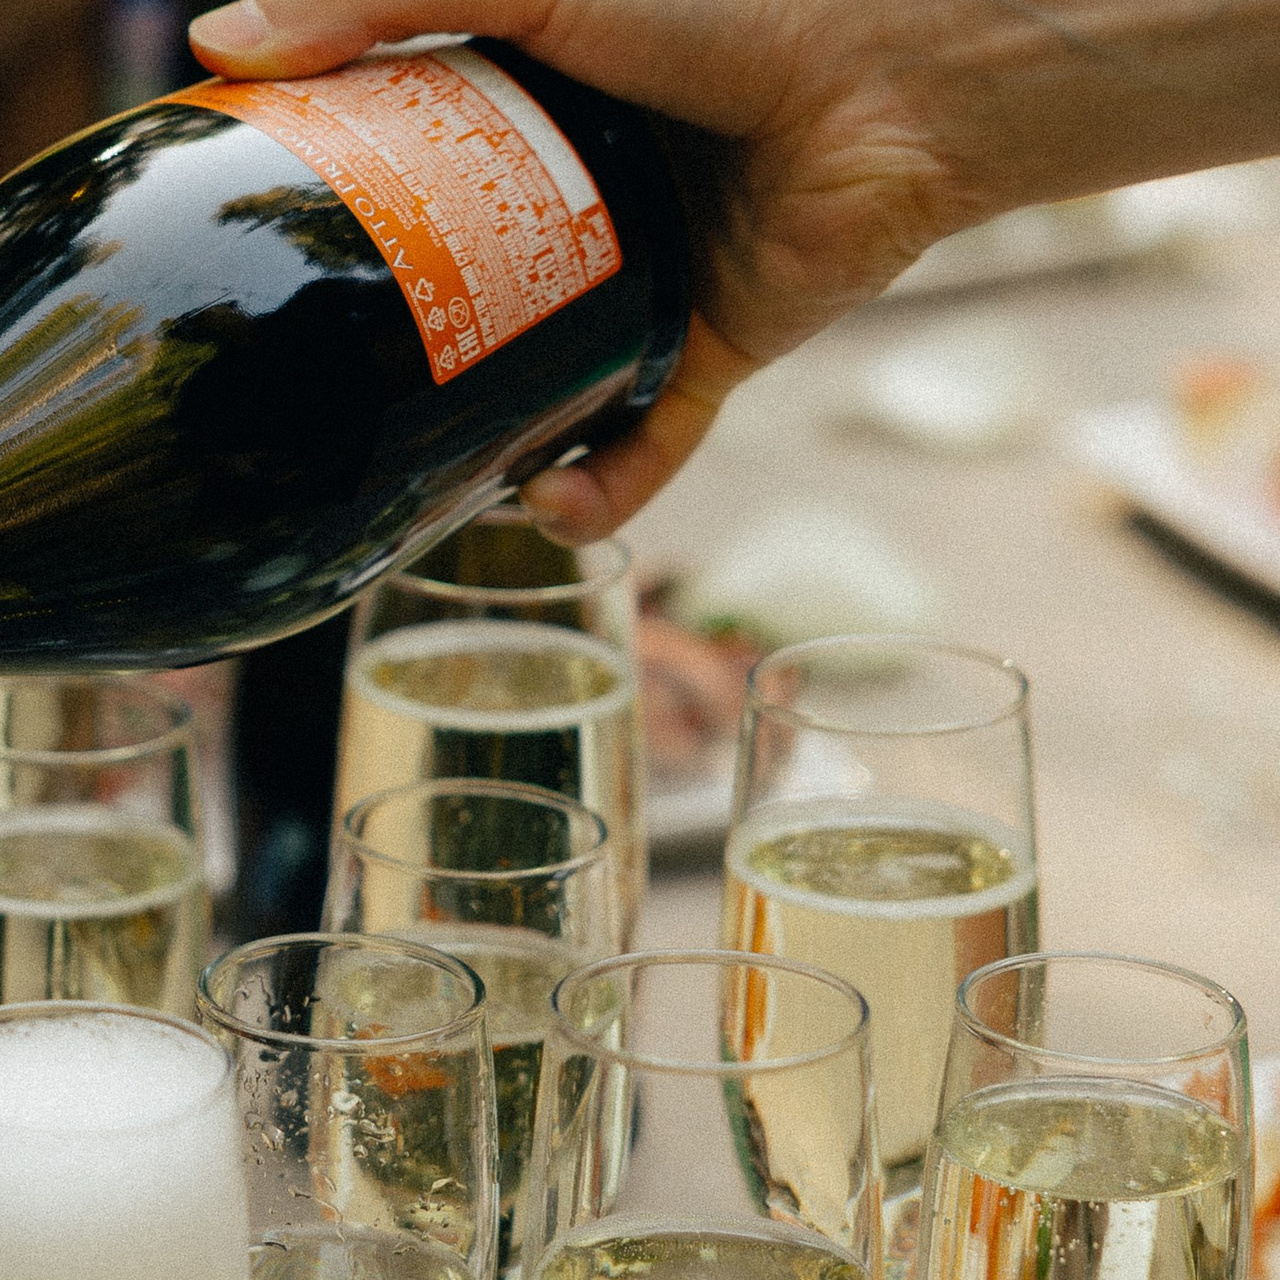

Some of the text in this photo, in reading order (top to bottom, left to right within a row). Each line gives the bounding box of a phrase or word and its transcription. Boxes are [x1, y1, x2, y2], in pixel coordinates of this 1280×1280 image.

[275, 125, 356, 195] PRIMO
[352, 194, 415, 268] ATTO
[422, 199, 452, 235] БЕЛОЕ
[441, 231, 469, 267] СУХОЕ
[458, 263, 482, 297] ВИНО
[470, 293, 497, 349] ИГРИСТОЕ
